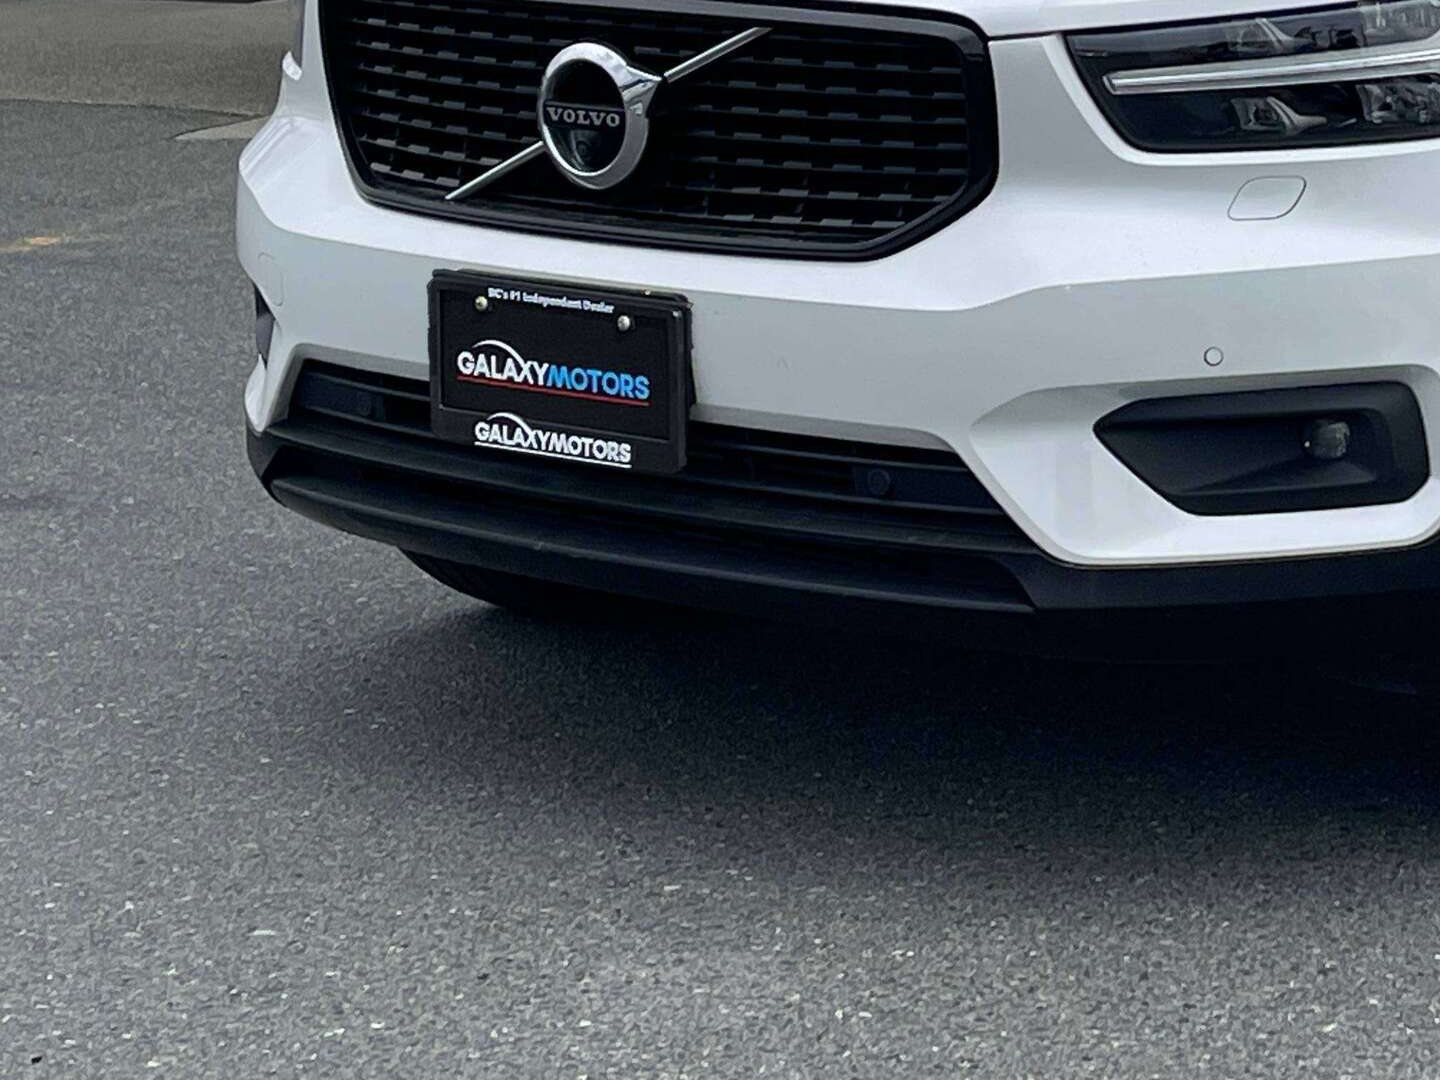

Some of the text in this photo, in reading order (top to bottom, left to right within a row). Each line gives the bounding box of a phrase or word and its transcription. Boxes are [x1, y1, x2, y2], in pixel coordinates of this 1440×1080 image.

[546, 106, 621, 128] VOLVO
[456, 340, 651, 400] GALAXYMOTORS
[474, 412, 632, 463] GALAXYMOTORS
